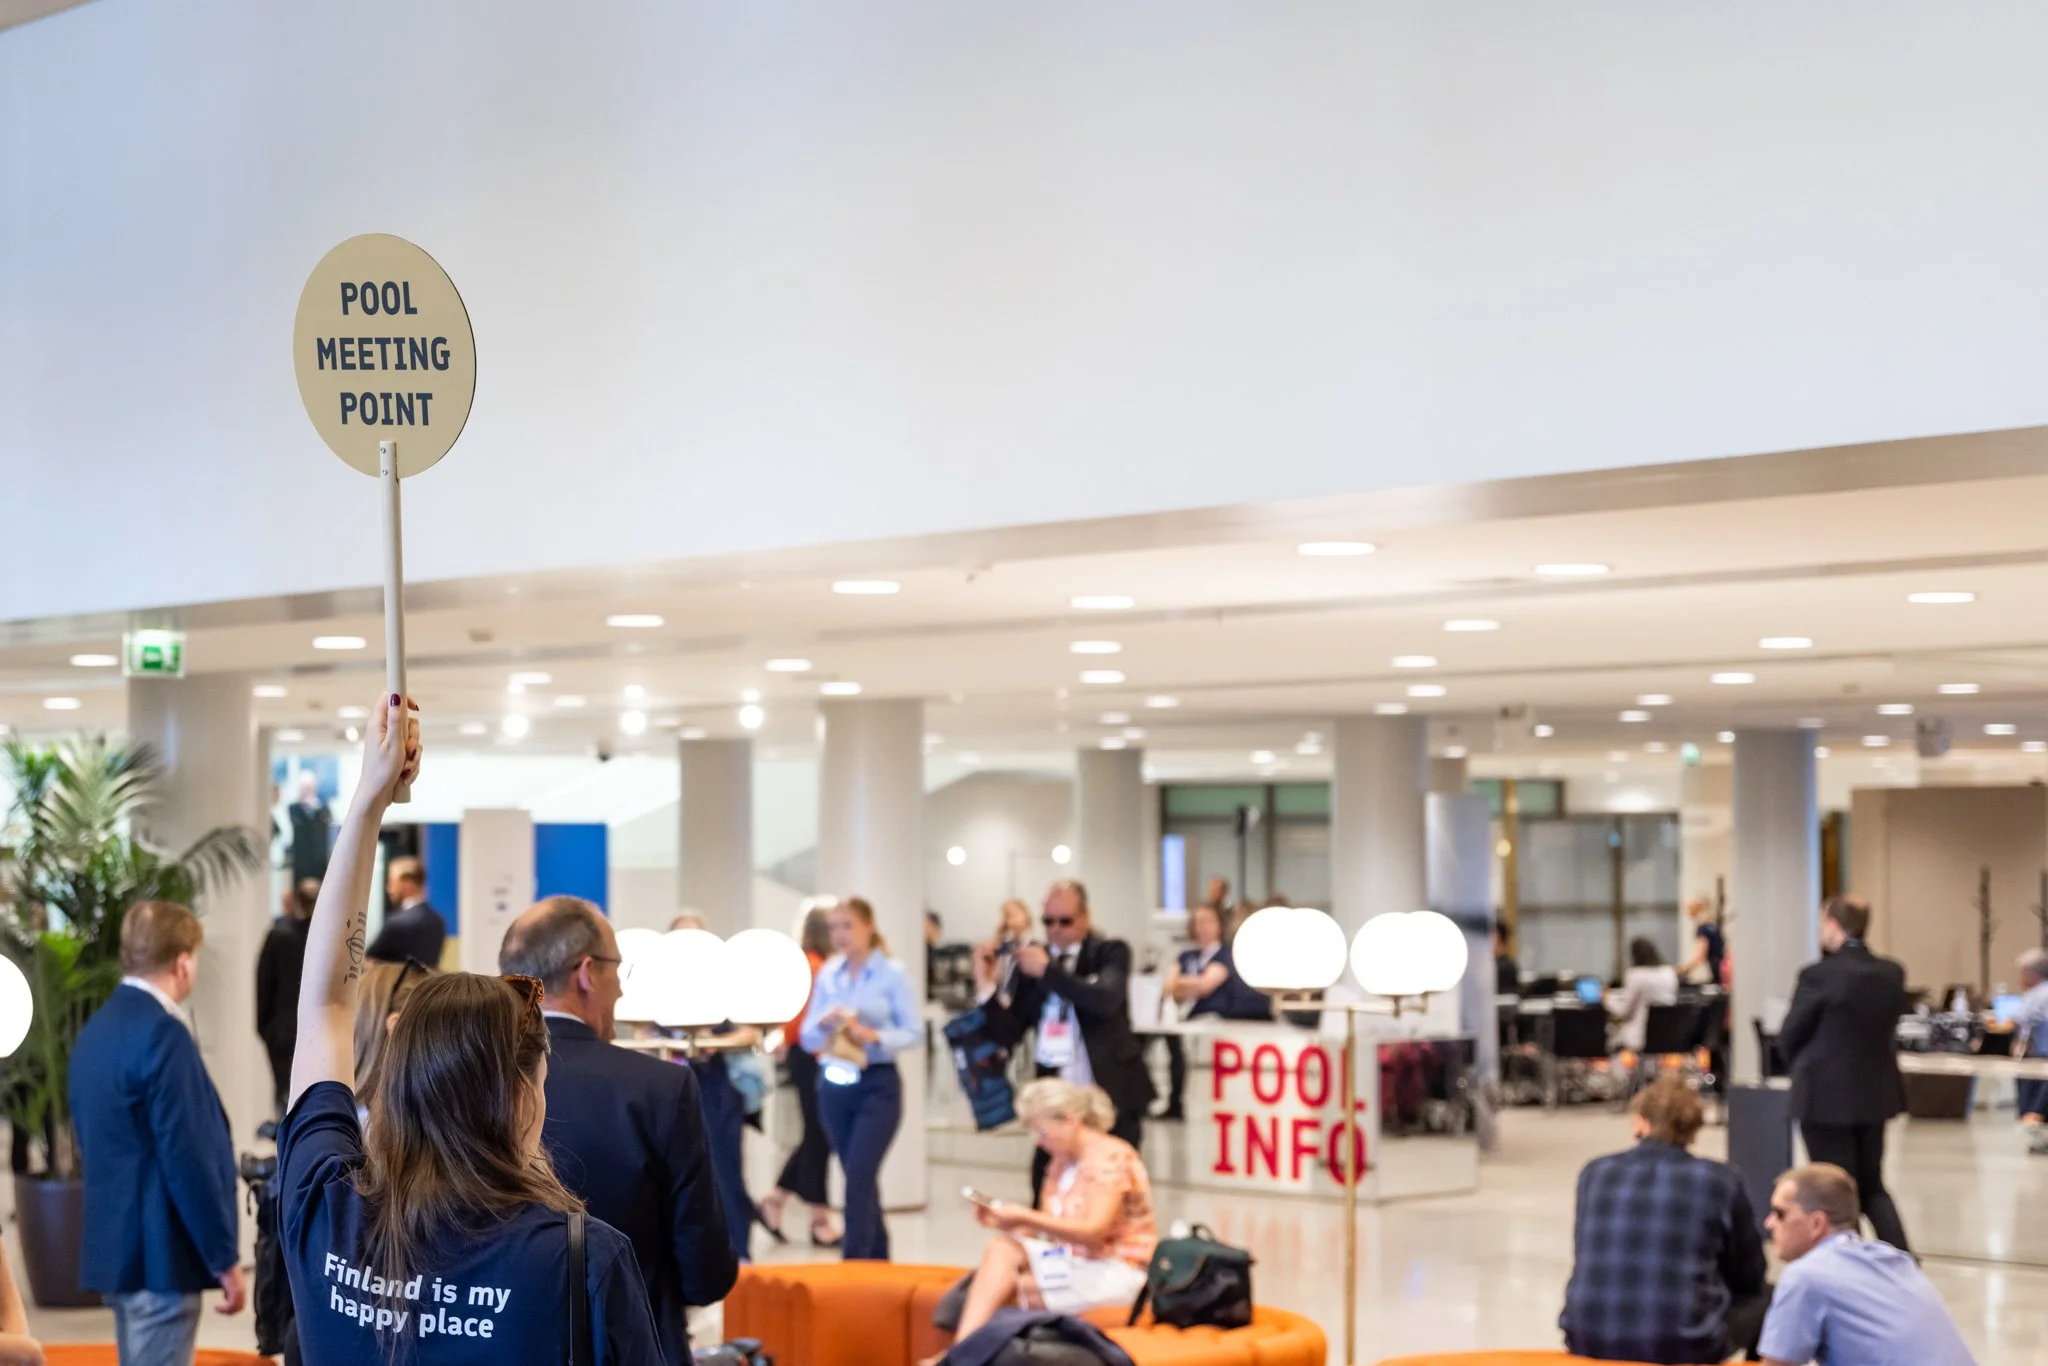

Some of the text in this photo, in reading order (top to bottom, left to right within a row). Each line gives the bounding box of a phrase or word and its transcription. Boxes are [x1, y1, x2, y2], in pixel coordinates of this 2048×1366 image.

[340, 281, 418, 316] POOL
[316, 336, 451, 371] MEETING
[340, 392, 433, 426] POINT
[1211, 1039, 1367, 1112] POOL
[1211, 1111, 1367, 1186] INFO
[324, 1252, 511, 1313] Finland is my
[330, 1286, 494, 1338] happy place
